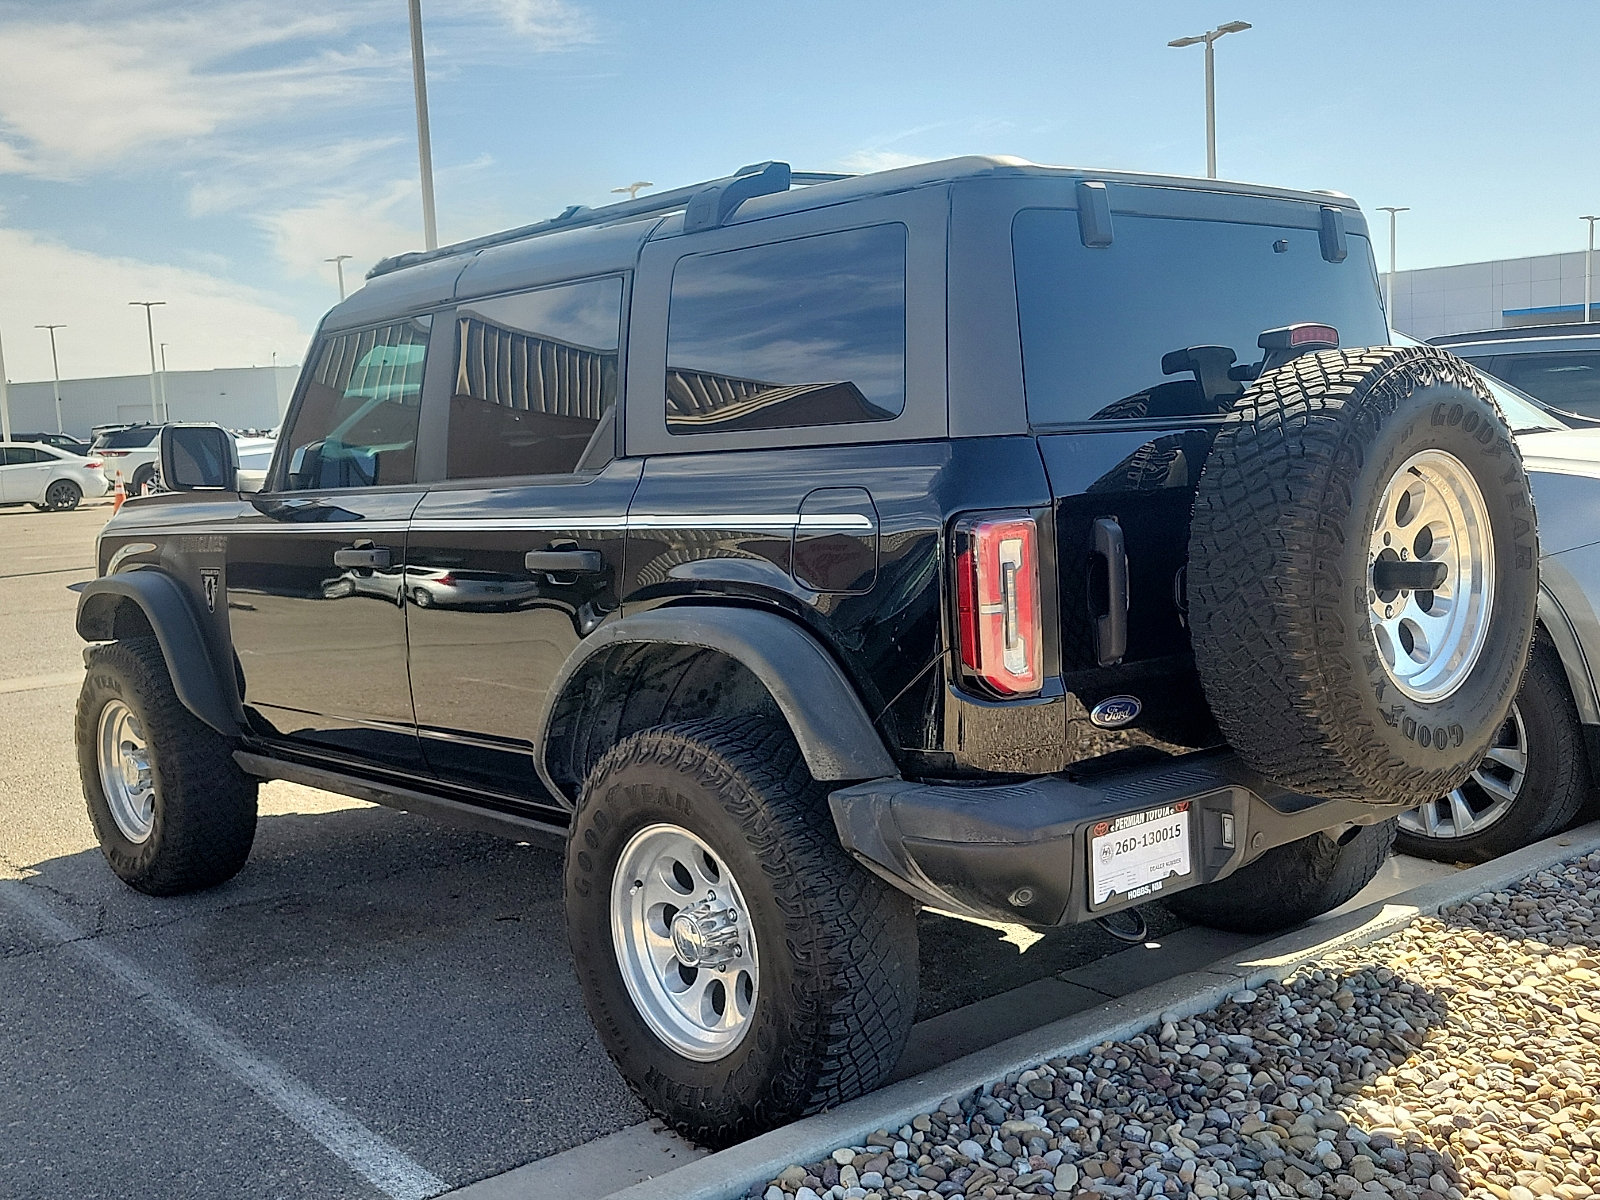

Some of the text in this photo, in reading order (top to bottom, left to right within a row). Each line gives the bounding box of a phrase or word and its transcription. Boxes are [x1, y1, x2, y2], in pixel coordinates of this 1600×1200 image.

[1105, 703, 1131, 721] Ford
[1115, 812, 1145, 831] PERMIAN
[1115, 823, 1181, 856] 26D-130015
